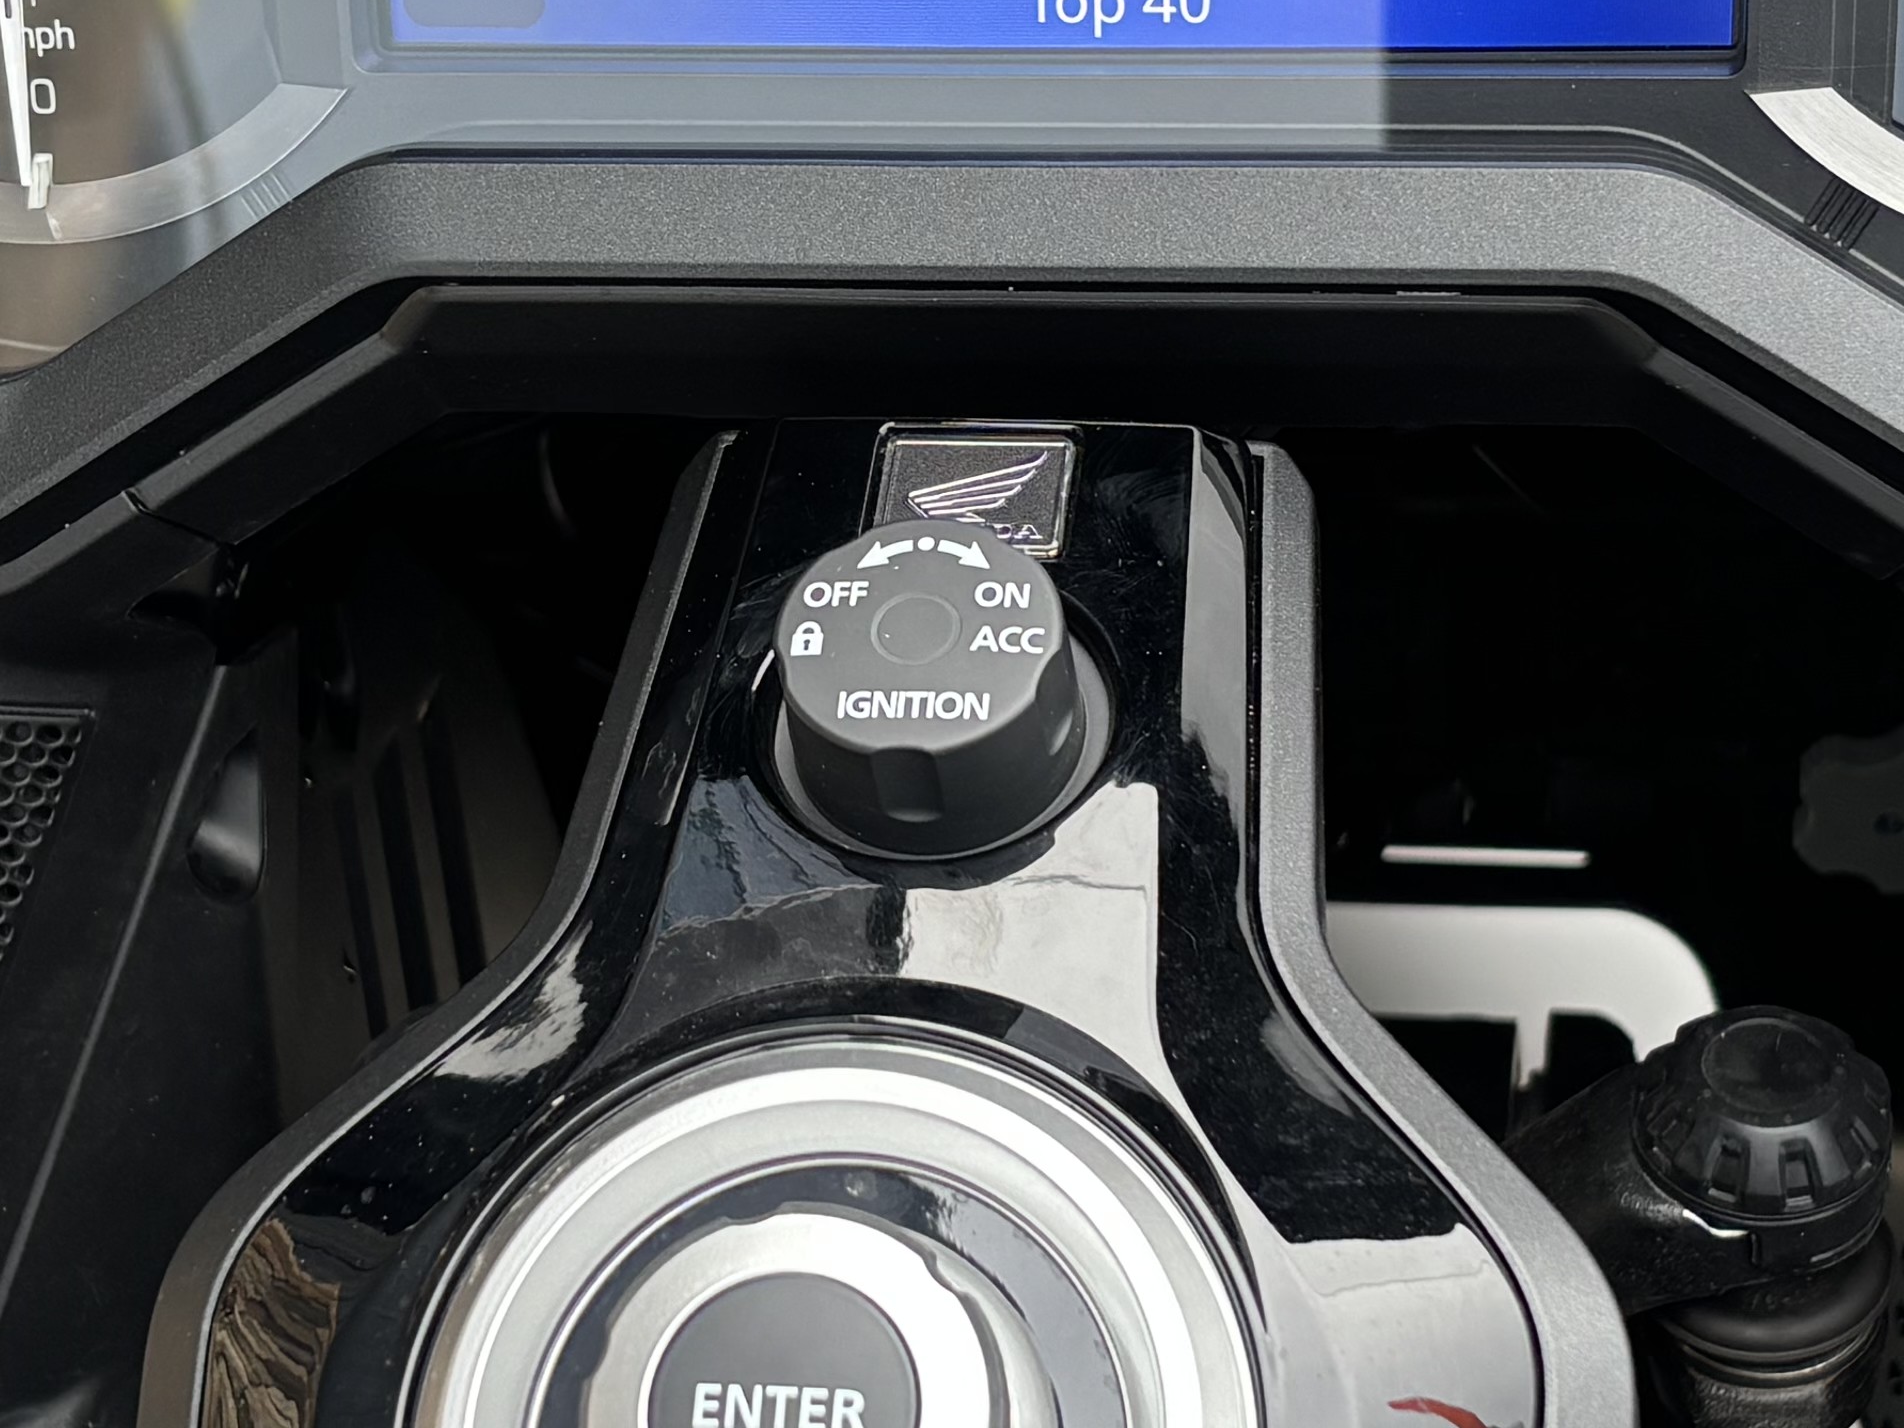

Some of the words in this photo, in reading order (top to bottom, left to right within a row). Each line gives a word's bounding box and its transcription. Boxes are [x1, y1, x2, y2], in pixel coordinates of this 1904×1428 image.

[30, 78, 56, 114] 0
[803, 581, 869, 607] OFF
[975, 582, 1030, 608] ON
[970, 626, 1045, 654] ACC
[837, 691, 990, 720] IGNITION
